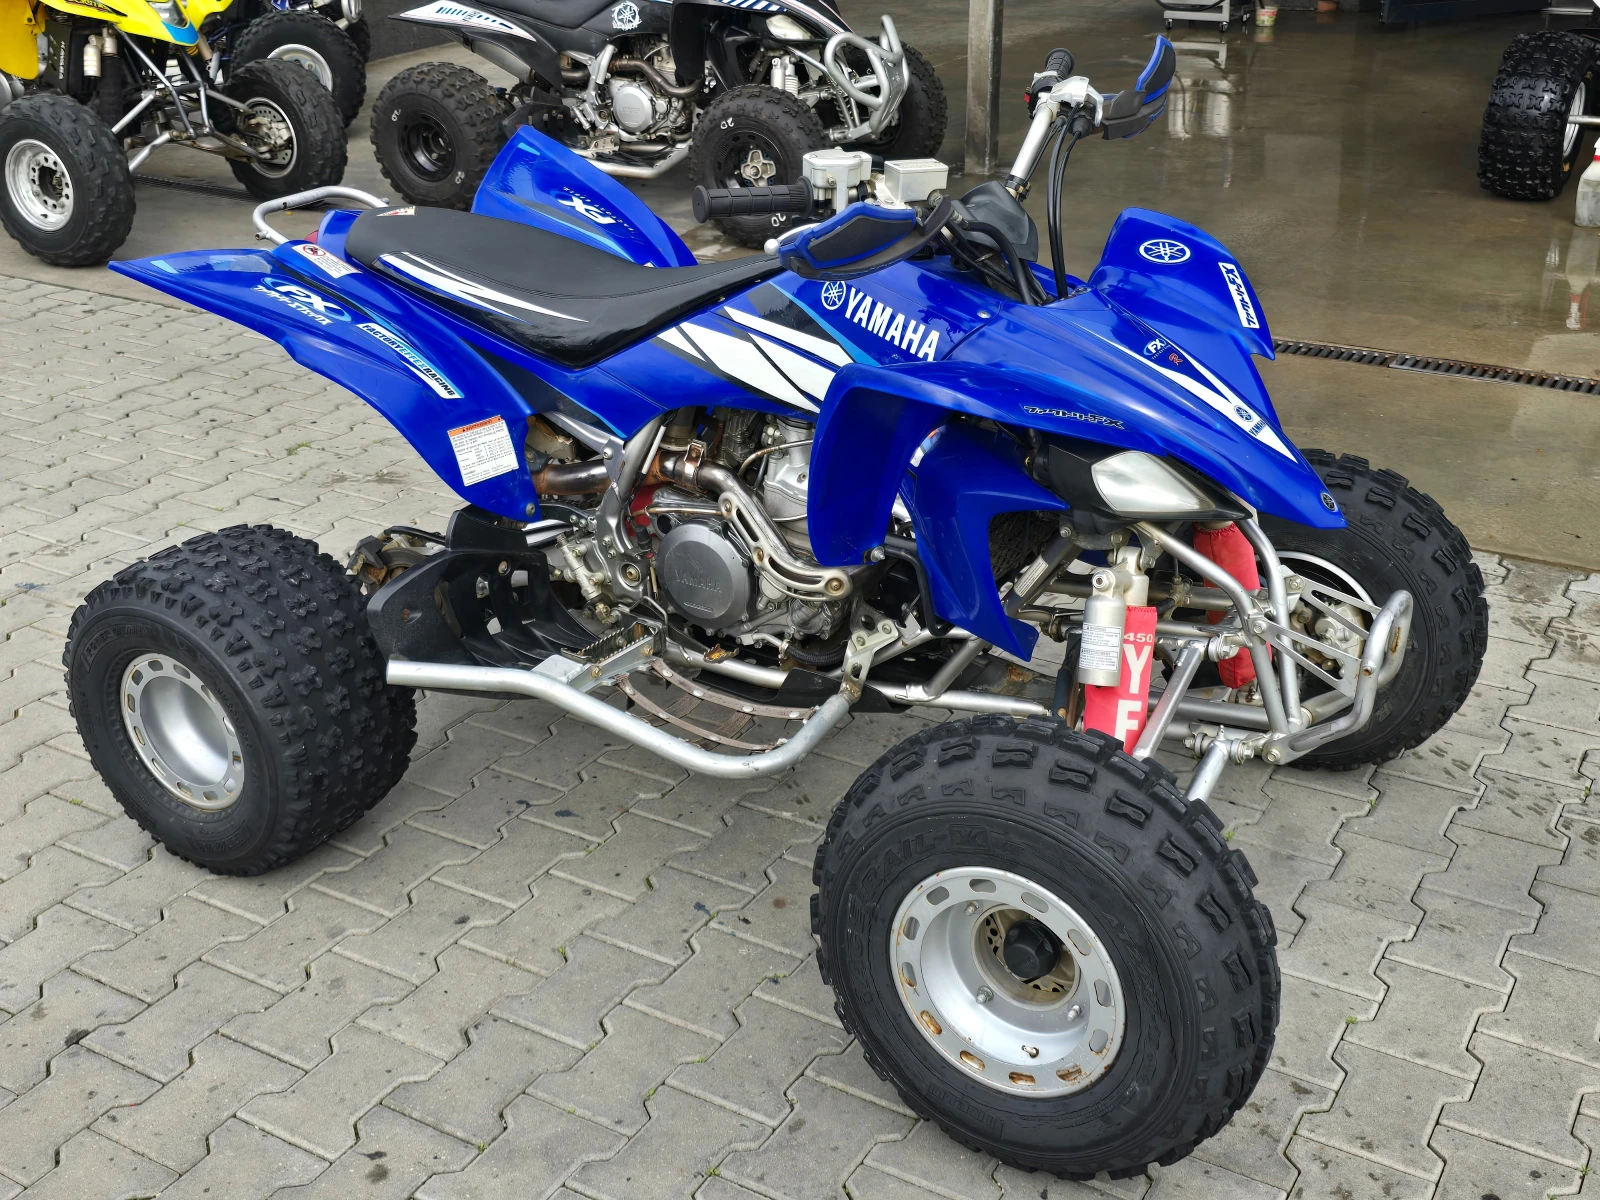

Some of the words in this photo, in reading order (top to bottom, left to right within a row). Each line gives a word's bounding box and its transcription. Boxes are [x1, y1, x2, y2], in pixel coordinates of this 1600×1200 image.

[274, 285, 342, 313] FX
[844, 286, 940, 362] YAMAHA
[1123, 632, 1153, 643] 450
